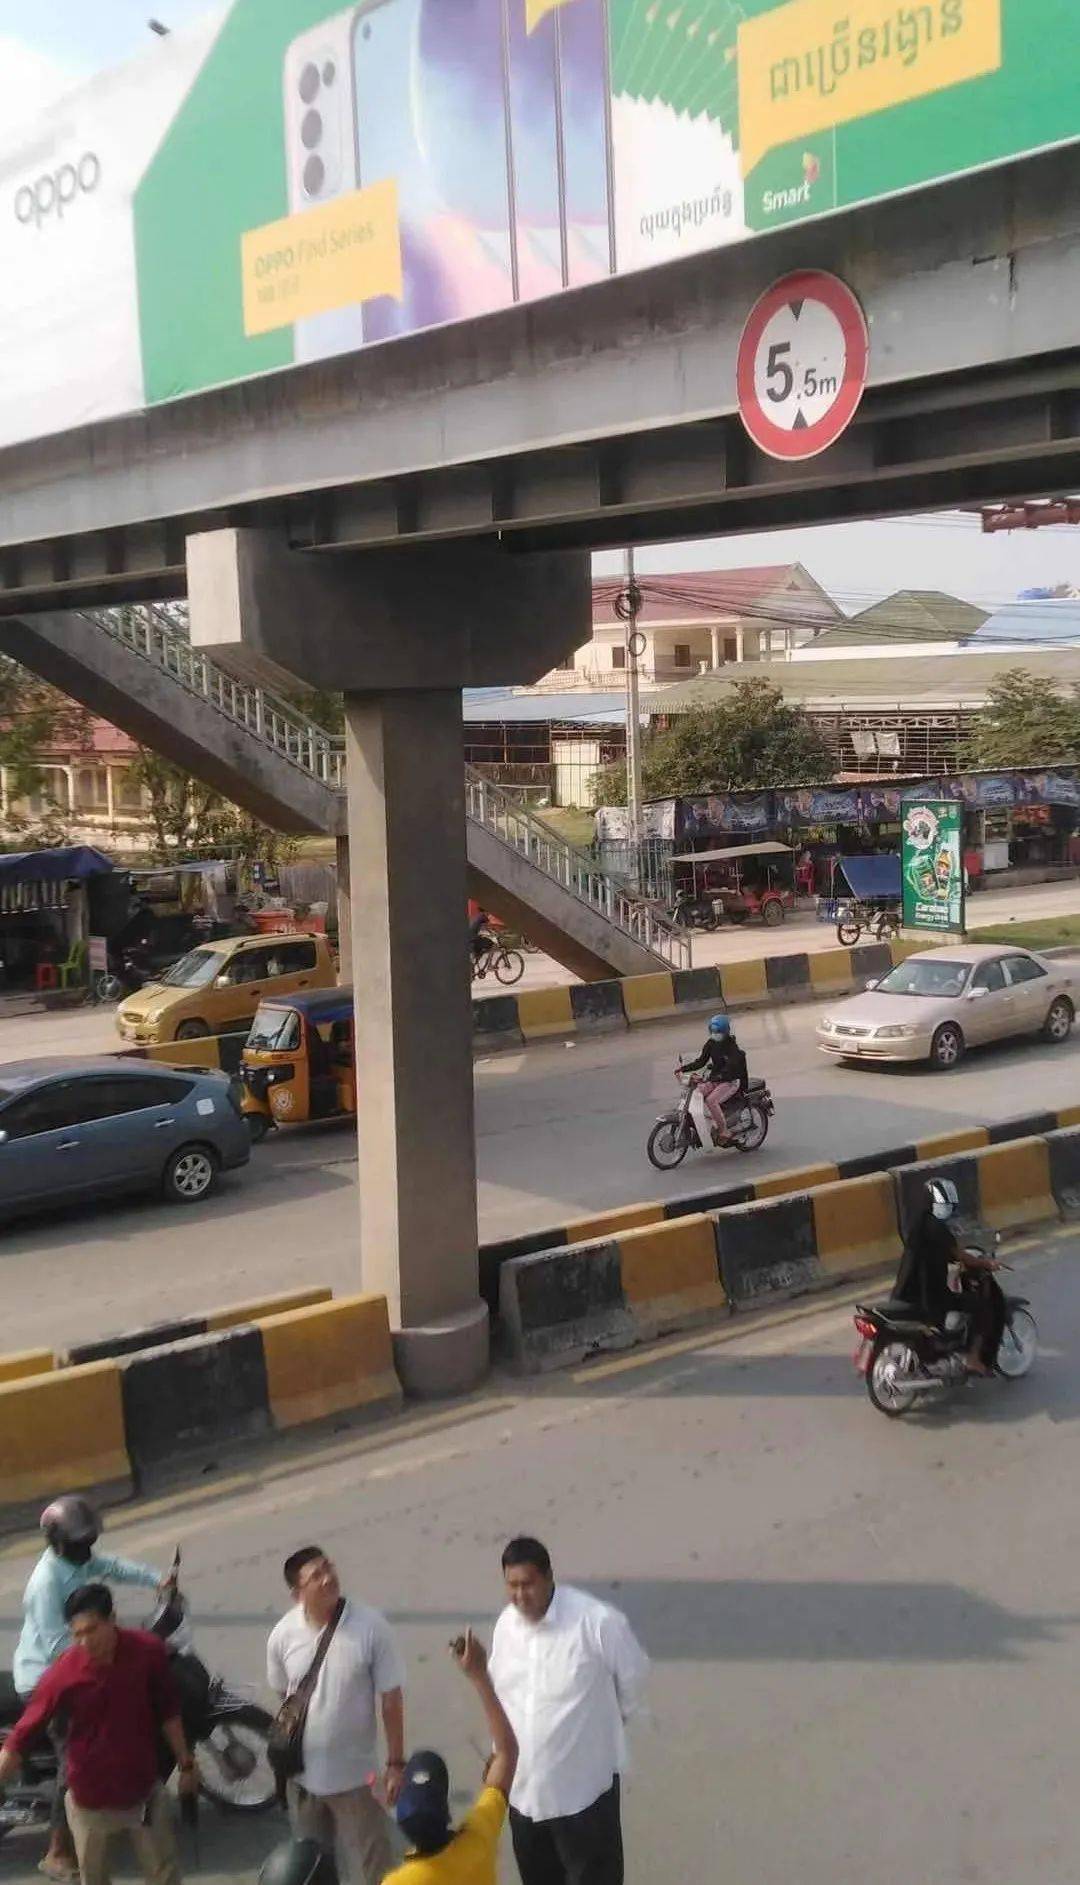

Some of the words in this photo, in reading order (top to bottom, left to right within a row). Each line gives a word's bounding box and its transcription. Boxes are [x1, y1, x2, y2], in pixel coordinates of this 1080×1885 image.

[769, 0, 963, 101] ជាច្រើនរង្វាន
[763, 180, 811, 214] Smart
[255, 247, 294, 279] OPPO
[298, 228, 327, 263] Find
[329, 220, 375, 255] Series
